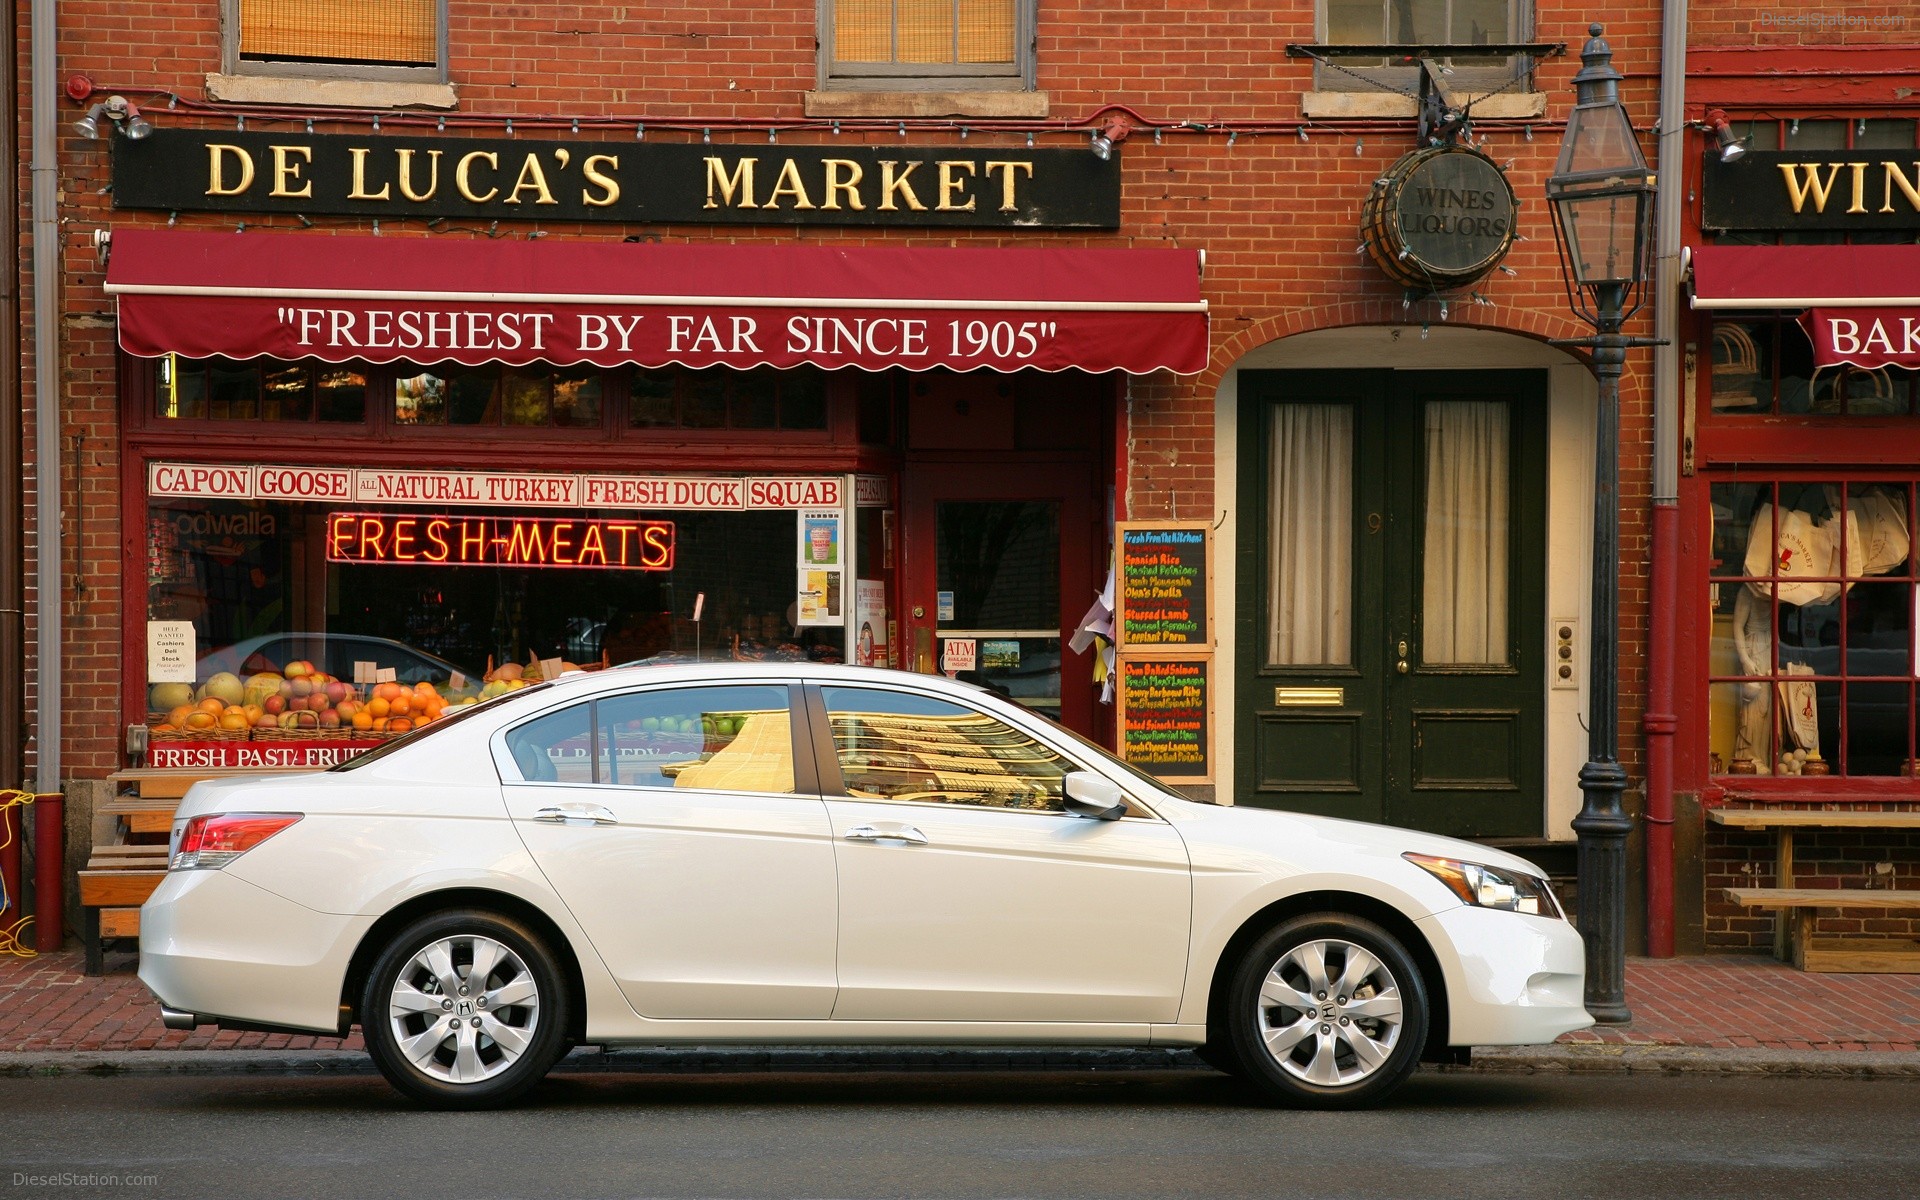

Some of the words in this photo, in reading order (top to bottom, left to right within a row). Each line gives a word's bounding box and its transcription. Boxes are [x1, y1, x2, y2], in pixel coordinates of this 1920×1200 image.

[205, 143, 313, 199] DE
[347, 147, 621, 208] LUCA'S
[702, 156, 1034, 213] MARKET
[1416, 186, 1495, 211] WINES
[1401, 211, 1506, 238] LIQUORS
[277, 307, 553, 352] "FRESHEST
[576, 313, 644, 353] BY
[666, 315, 763, 354] FAR
[786, 315, 928, 357] SINCE
[948, 319, 1057, 359] 1905"
[155, 467, 248, 494] CAPON
[259, 470, 348, 497] GOOSE
[359, 479, 377, 491] ALL
[377, 474, 480, 500] NATURAL
[486, 476, 574, 502] TURKEY
[586, 479, 669, 505] FRESH
[674, 481, 740, 507] DUCK
[750, 480, 838, 507] SQUAB
[1367, 512, 1382, 535] 9
[1125, 554, 1158, 566] Spanish
[1160, 553, 1180, 565] Rice
[1125, 565, 1158, 576] Mashed
[1125, 609, 1160, 621] Stuffed
[1161, 609, 1189, 621] Lamb
[946, 641, 975, 656] ATM
[1162, 630, 1187, 642] Parm
[152, 748, 227, 767] FRESH
